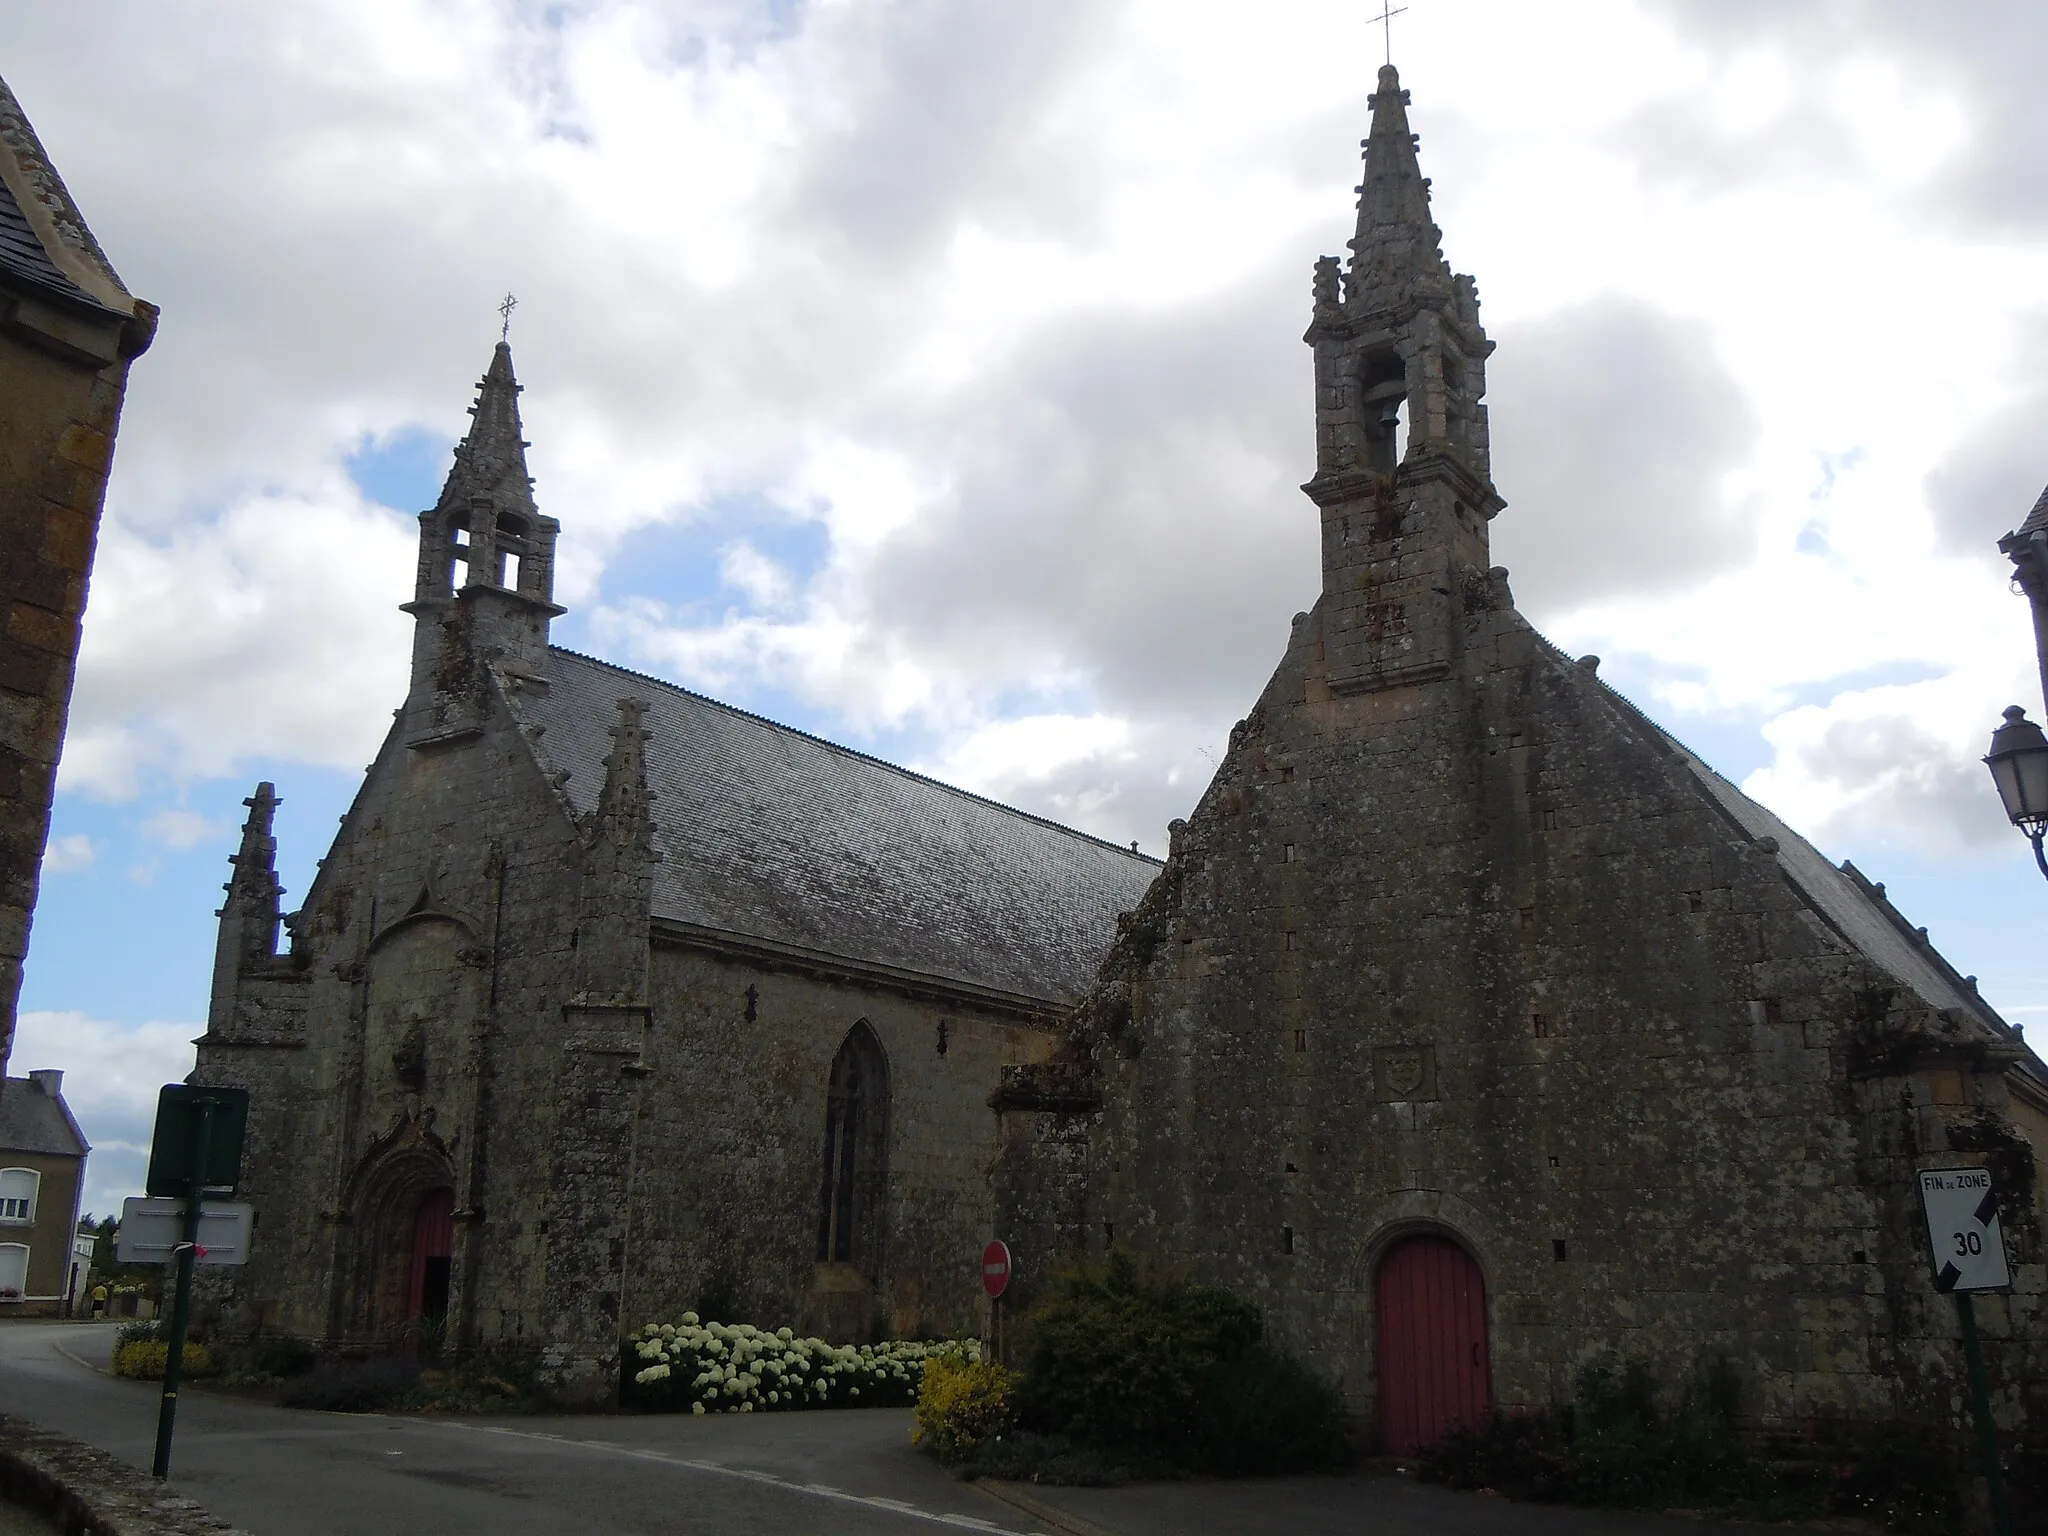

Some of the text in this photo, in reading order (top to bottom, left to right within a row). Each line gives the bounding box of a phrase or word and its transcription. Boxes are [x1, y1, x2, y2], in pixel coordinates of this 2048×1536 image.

[1924, 1177, 1943, 1190] FIN
[1956, 1174, 1988, 1188] ZONE
[1953, 1231, 1981, 1256] 30
